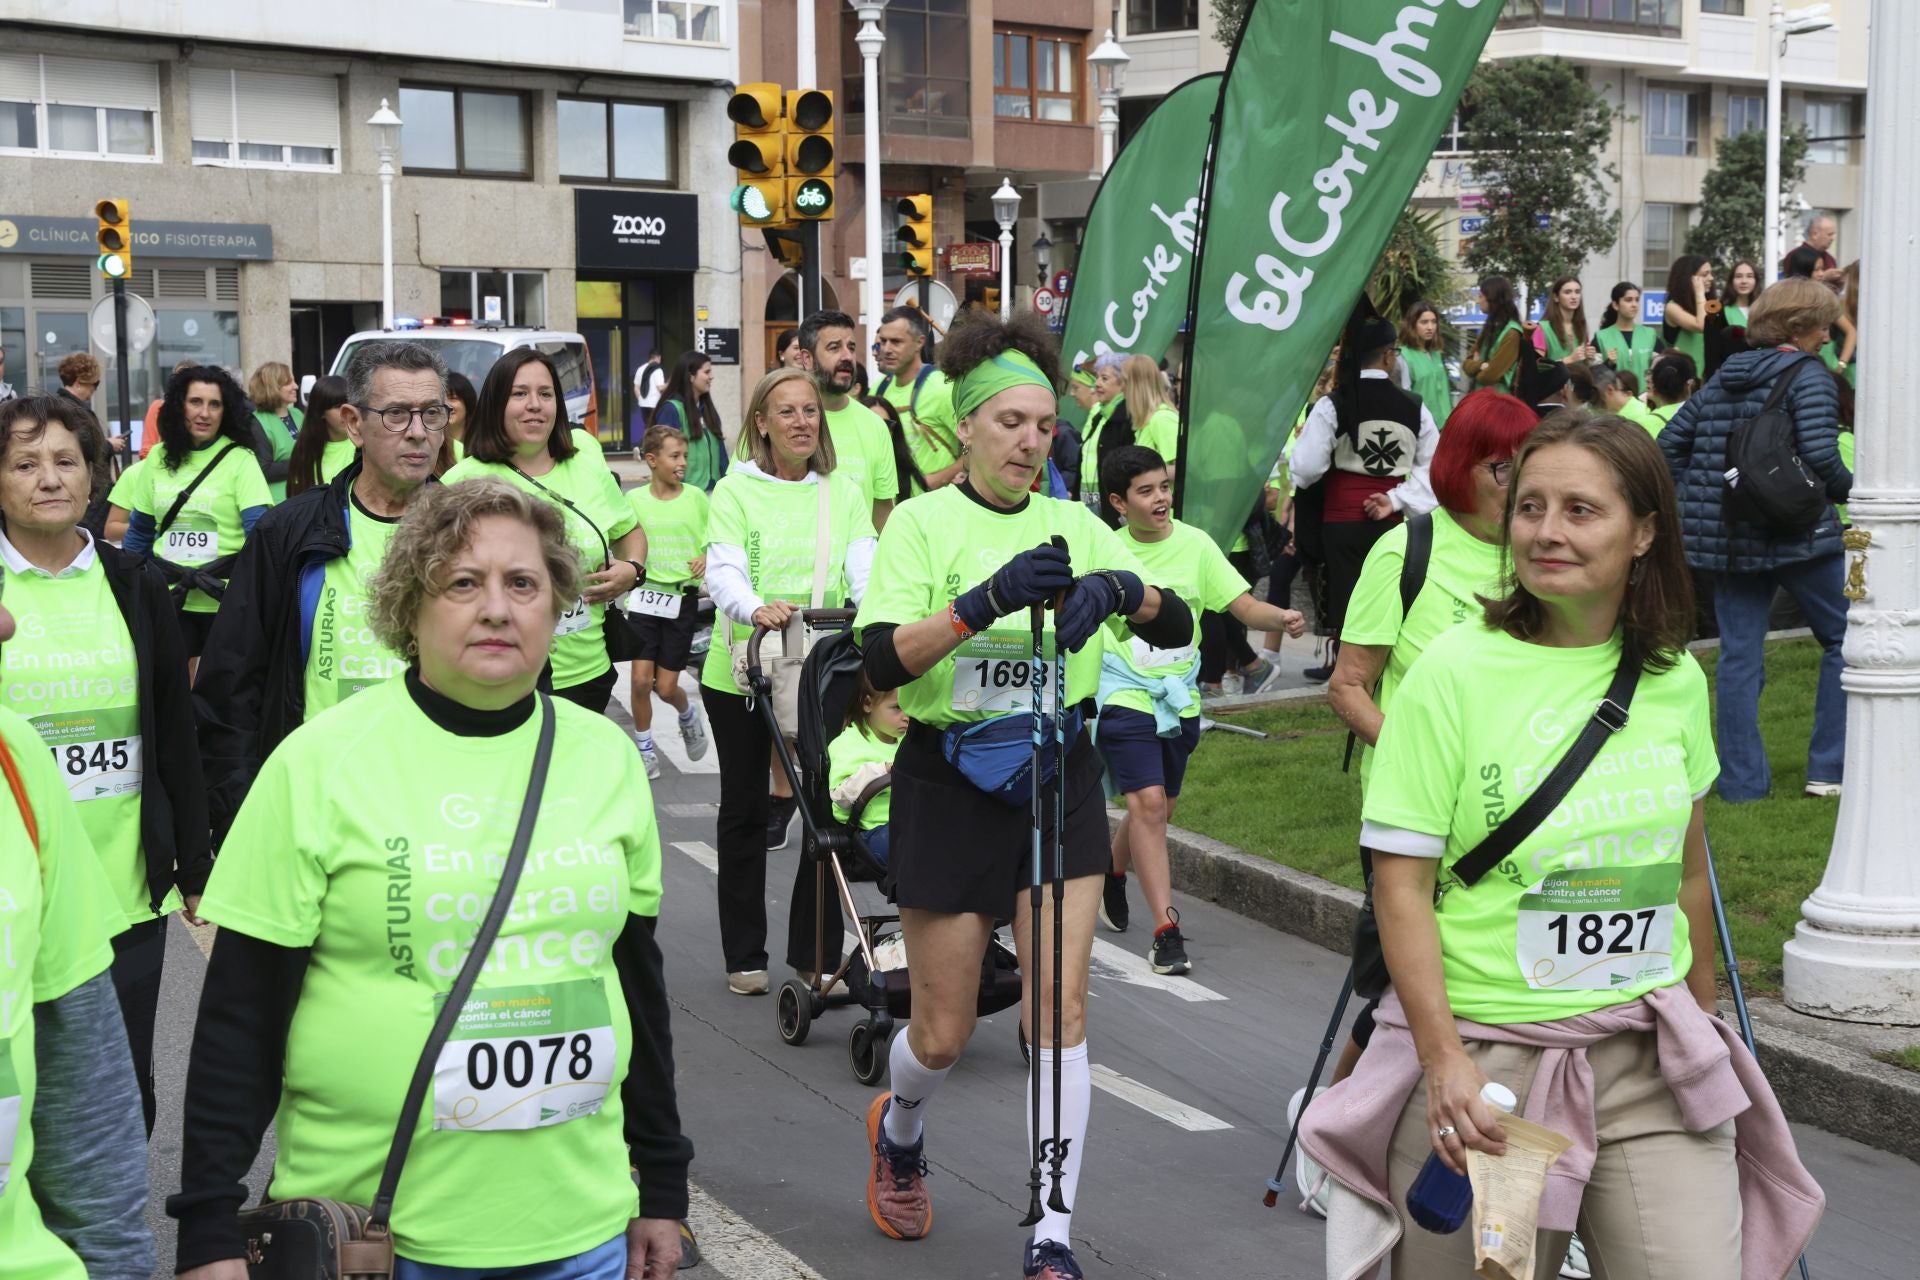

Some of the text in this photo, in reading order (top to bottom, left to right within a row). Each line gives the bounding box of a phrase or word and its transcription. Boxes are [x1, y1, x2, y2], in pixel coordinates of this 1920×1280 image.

[1269, 88, 1400, 258] Corte
[29, 227, 90, 242] CLÍNICA
[165, 233, 257, 248] FISIOTERAPIA
[1039, 296, 1052, 306] 30
[169, 531, 208, 548] 0769
[750, 530, 761, 592] ASTURIAS
[640, 590, 674, 607] 1377
[319, 587, 336, 681] ASTURIAS
[971, 641, 1025, 651] contra el cáncer
[6, 642, 132, 671] En march
[8, 675, 114, 702] contra
[39, 728, 60, 736] ontra
[70, 724, 96, 733] cáncer
[1587, 740, 1682, 777] archa
[1546, 783, 1657, 830] ontra
[423, 842, 475, 874] En
[1530, 825, 1681, 874] cánce
[585, 874, 620, 914] el
[1542, 886, 1622, 898] contra el cáncer
[1543, 877, 1621, 889] Gijón en marcha
[384, 835, 417, 984] ASTURIAS
[1548, 908, 1657, 956] 1827
[457, 1007, 553, 1023] contra el cáncer
[490, 1000, 506, 1010] en
[508, 996, 553, 1008] marcha
[467, 1032, 593, 1091] 0078
